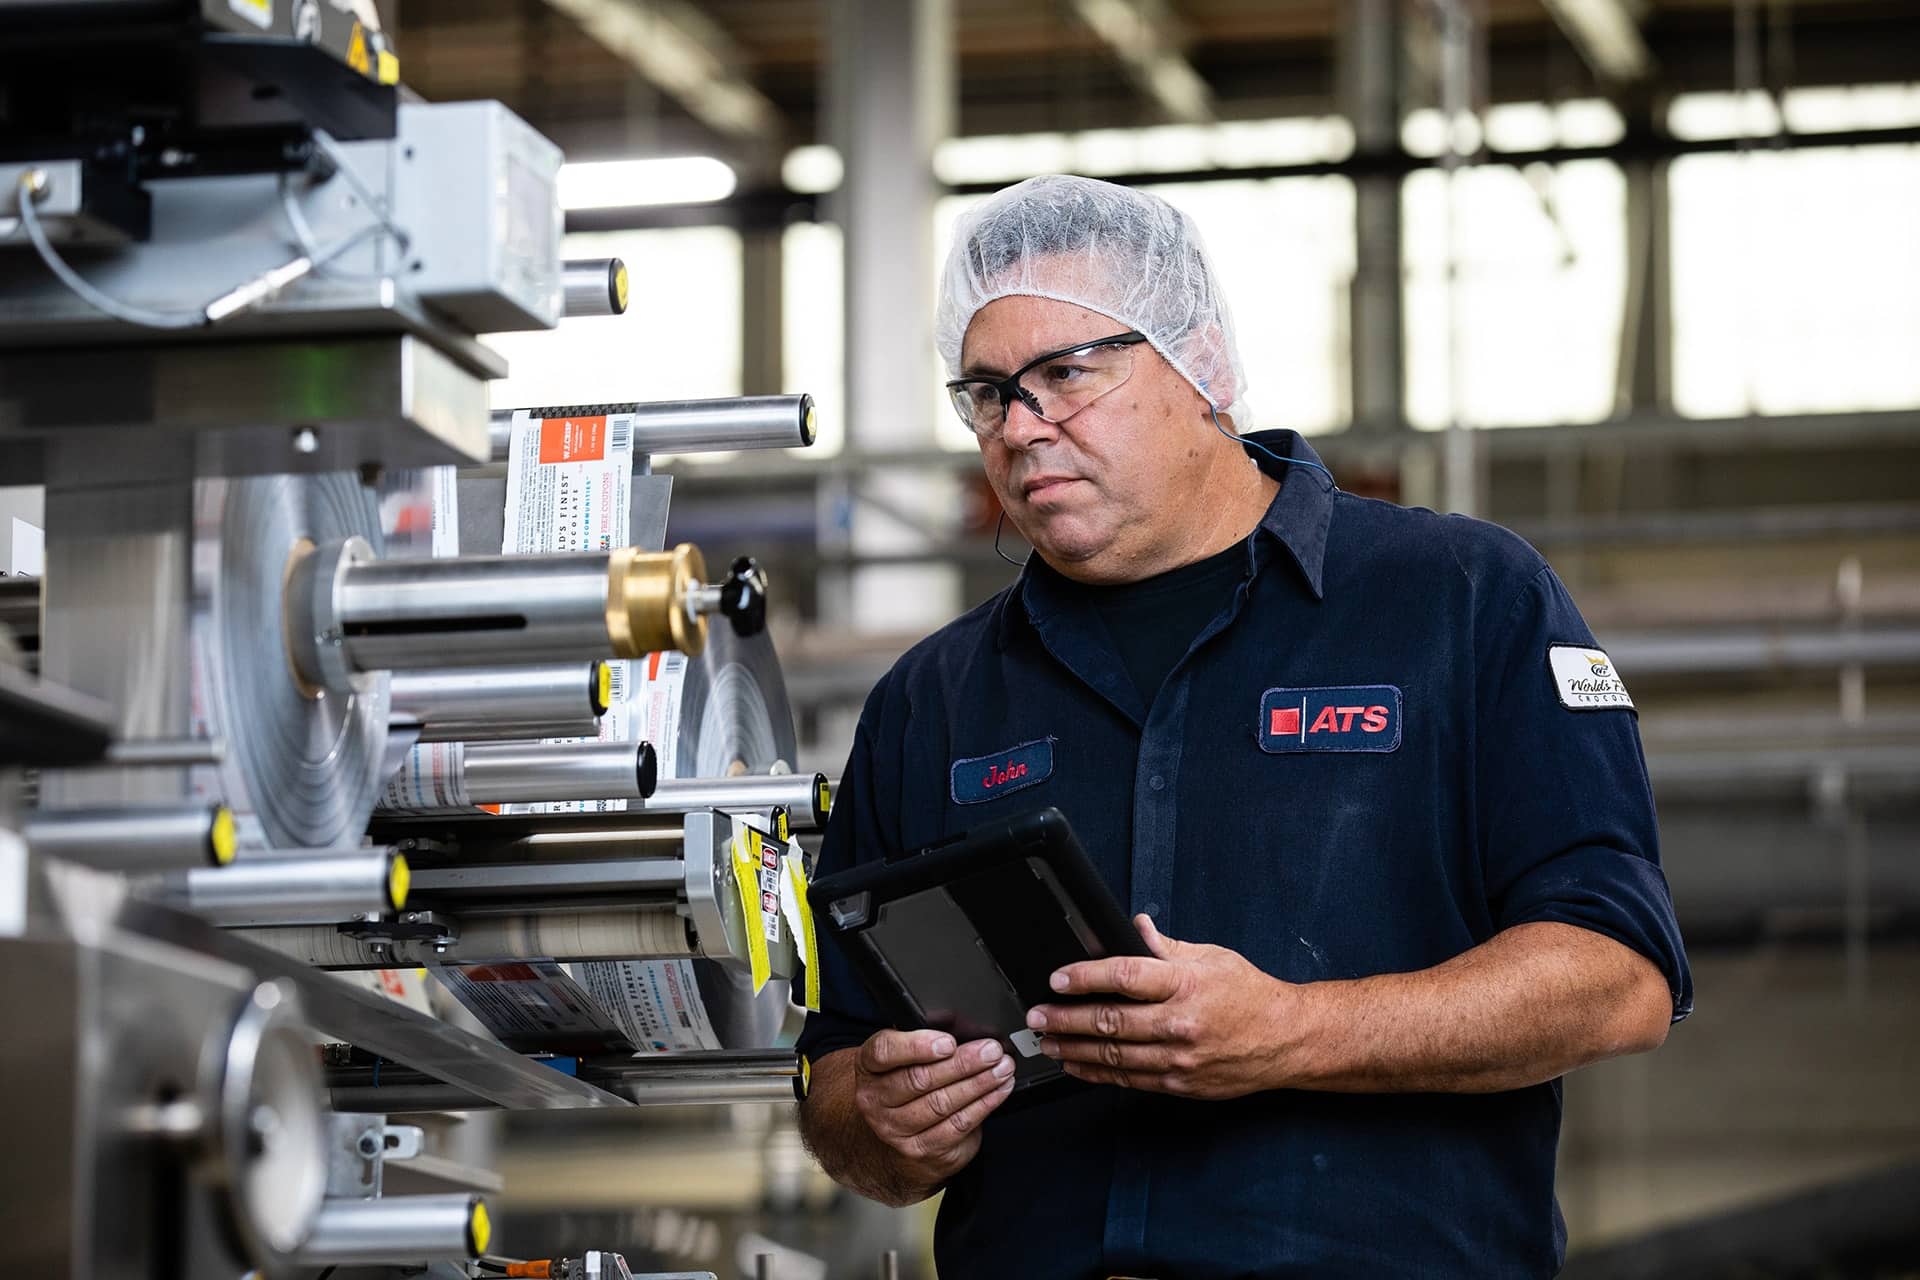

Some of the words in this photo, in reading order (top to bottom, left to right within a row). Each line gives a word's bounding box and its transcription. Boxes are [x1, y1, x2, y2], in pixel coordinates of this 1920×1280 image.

[560, 474, 569, 518] FINEST
[558, 526, 567, 550] LD'S
[1568, 678, 1611, 692] World's
[1309, 705, 1389, 733] ATS
[982, 758, 1028, 788] John
[622, 962, 638, 1000] FINEST
